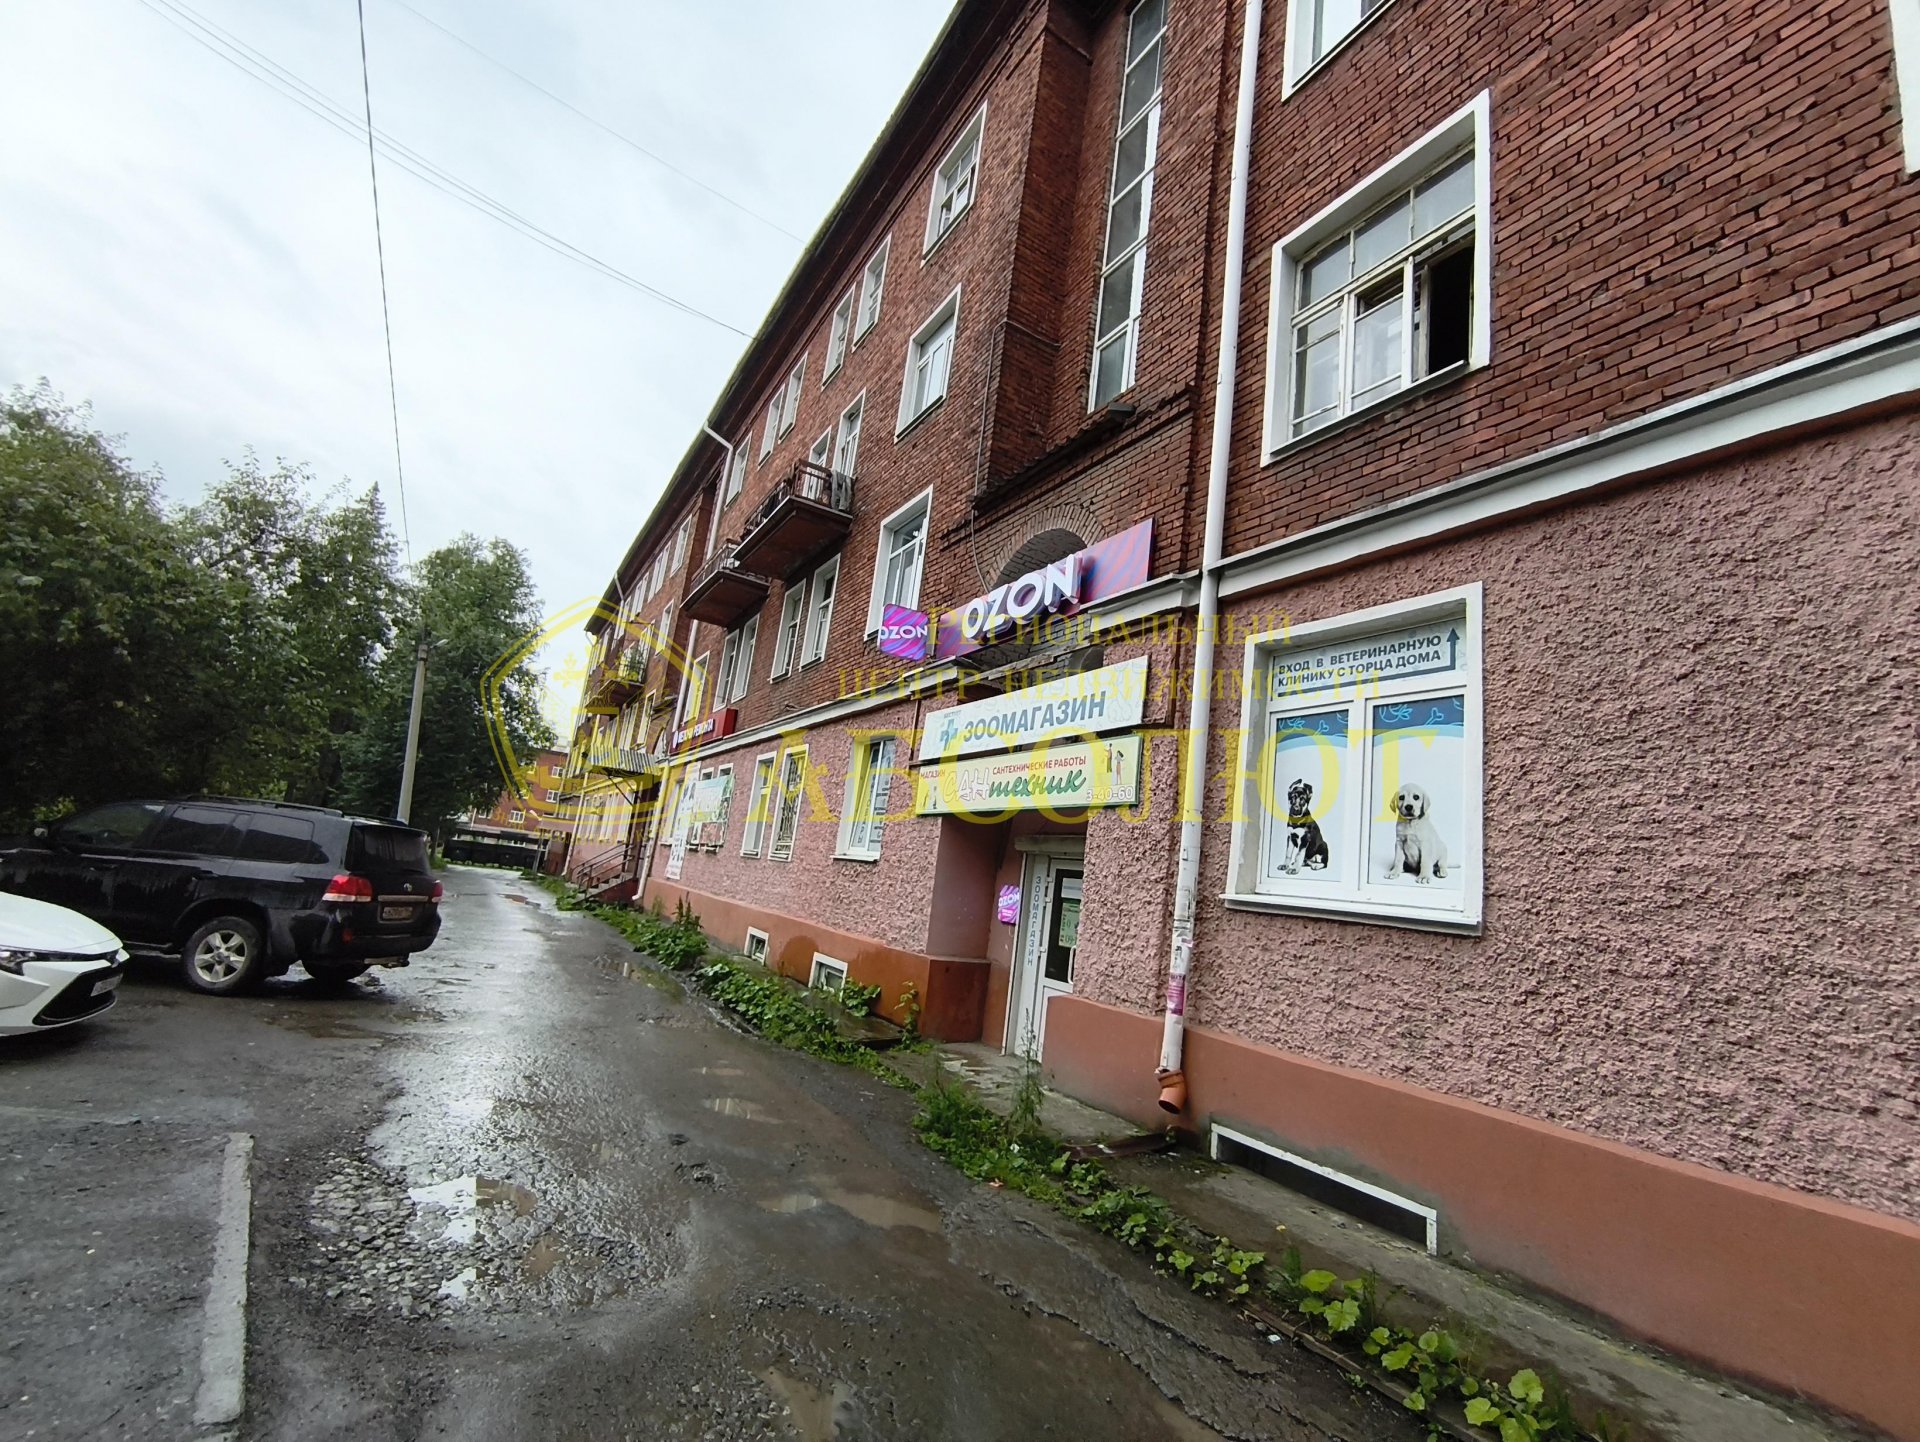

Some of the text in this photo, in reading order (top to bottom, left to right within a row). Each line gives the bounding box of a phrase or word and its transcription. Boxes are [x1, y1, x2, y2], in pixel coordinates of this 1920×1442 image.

[962, 552, 1080, 639] OZON
[880, 623, 928, 640] OZON
[1278, 635, 1441, 675] ВХОД В ВЕТЕРИНАРНУЮ
[1278, 650, 1441, 687] КЛИНИКУ С ТОРЦА ДОМА
[963, 691, 1107, 743] ЗООМАГАЗИН
[920, 768, 946, 780] МАГАЗИН
[992, 755, 1087, 775] САНТЕХНИЧЕСКИЕ РАБОТЫ
[1025, 875, 1042, 966] ЗООМАГАЗИН
